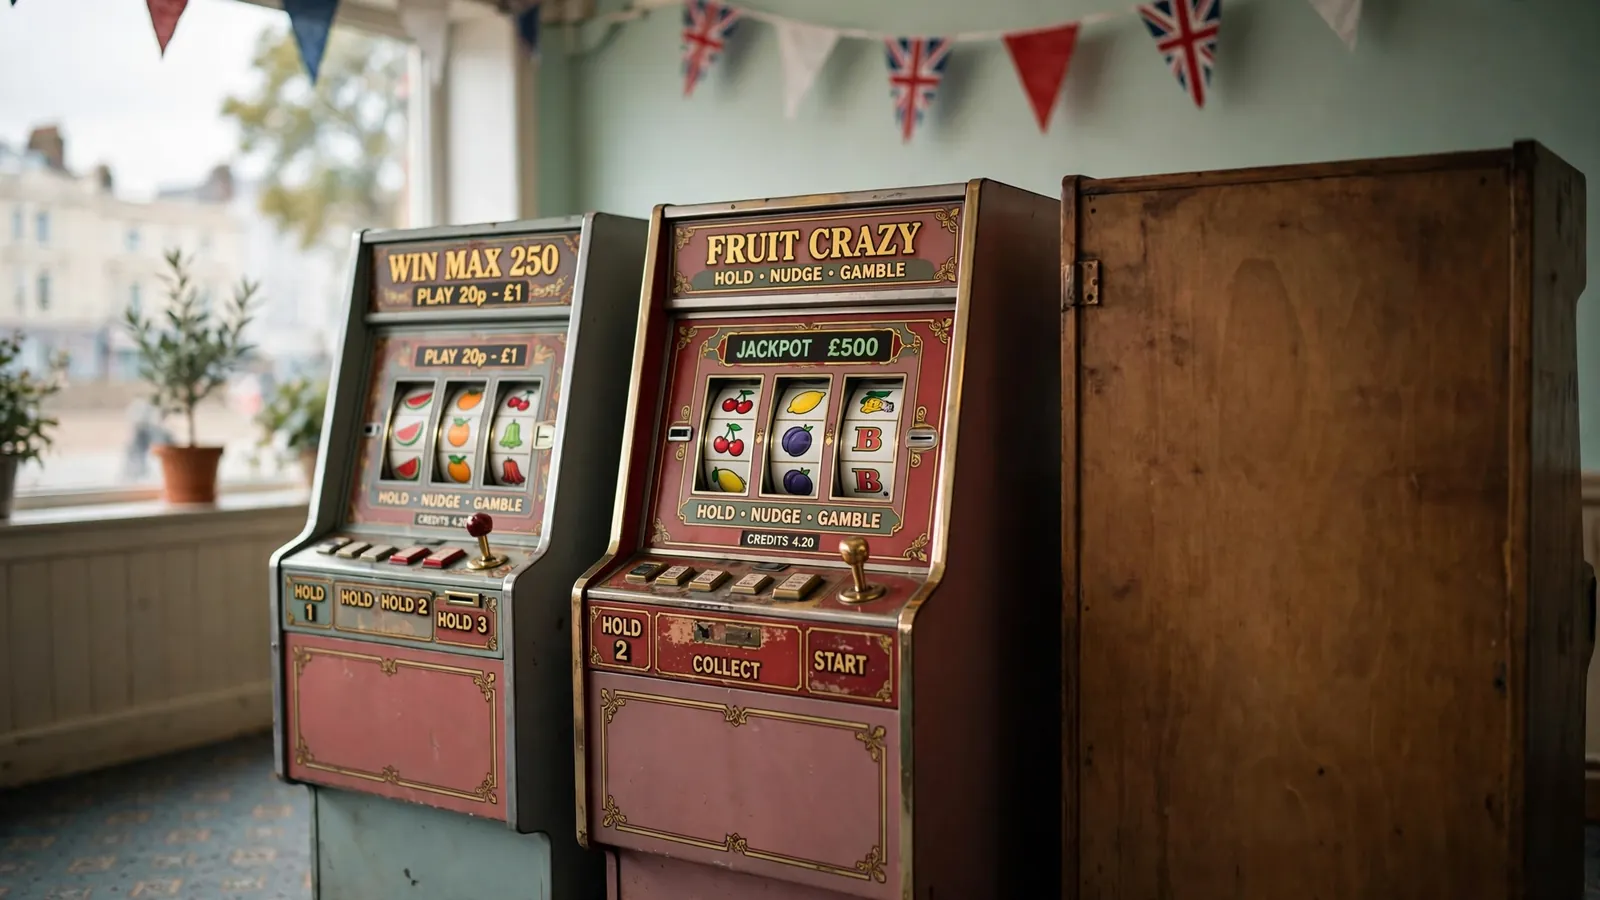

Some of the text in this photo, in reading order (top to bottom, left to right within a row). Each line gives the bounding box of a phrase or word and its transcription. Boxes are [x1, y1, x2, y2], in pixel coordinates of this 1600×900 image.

[705, 222, 922, 266] FRUIT CRAZY
[388, 244, 559, 284] WIN MAX 250
[714, 269, 754, 286] HOLD
[769, 266, 823, 283] NUDGE
[840, 262, 906, 280] GAMBLE
[416, 286, 455, 306] PLAY
[458, 286, 487, 307] 20p
[503, 283, 522, 302] £1
[423, 348, 458, 366] PLAY
[461, 348, 487, 369] 20p
[500, 347, 518, 365] £1
[736, 337, 879, 359] JACKPOT £500
[851, 425, 883, 452] B
[378, 490, 410, 506] HOLD
[421, 492, 461, 509] NUDGE
[473, 496, 523, 513] GAMBLE
[417, 513, 450, 527] CREDITS
[697, 504, 736, 521] HOLD
[750, 506, 801, 525] NUDGE
[817, 509, 882, 529] GAMBLE
[747, 533, 815, 548] CREDITS 4.20
[294, 583, 325, 601] HOLD
[341, 589, 373, 608] HOLD
[381, 593, 415, 613] HOLD
[418, 598, 429, 615] 2
[305, 603, 314, 621] 1
[437, 611, 488, 634] HOLD 3
[602, 616, 642, 638] HOLD
[615, 640, 628, 661] 2
[692, 655, 761, 680] COLLECT
[814, 650, 868, 675] START
